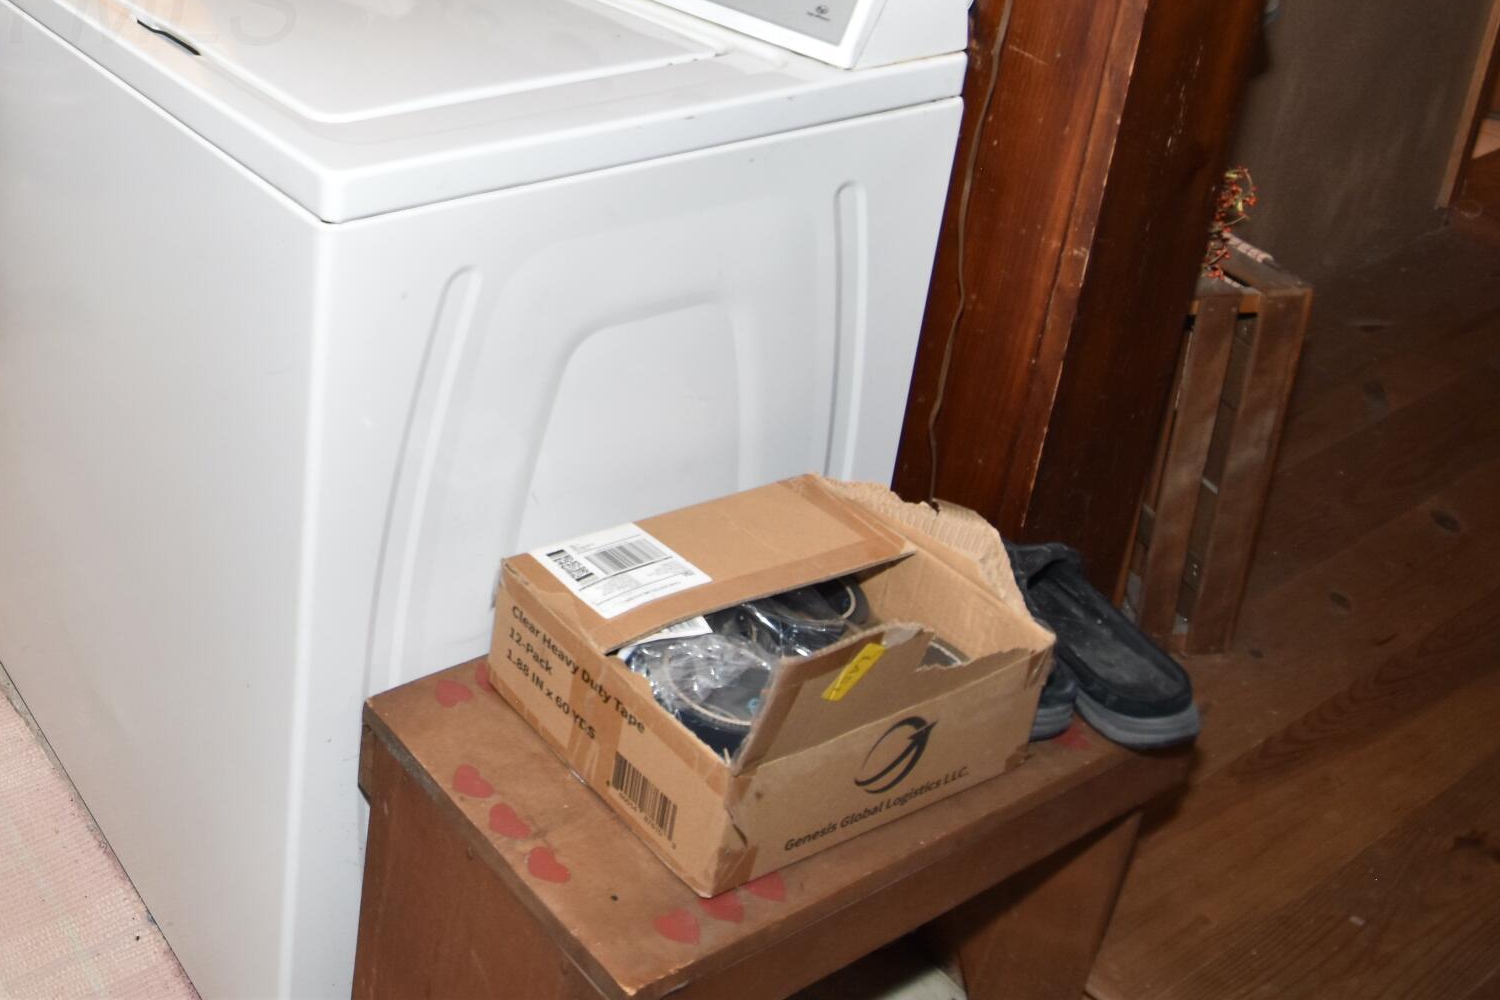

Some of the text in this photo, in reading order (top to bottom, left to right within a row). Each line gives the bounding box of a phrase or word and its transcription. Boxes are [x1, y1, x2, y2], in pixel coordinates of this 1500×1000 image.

[508, 627, 553, 676] 12-Pack
[512, 605, 646, 734] Clear Heavy Duty Tape
[531, 672, 545, 692] IN
[555, 696, 571, 716] 60
[784, 766, 970, 851] Genesis Global Logistics LLC.
